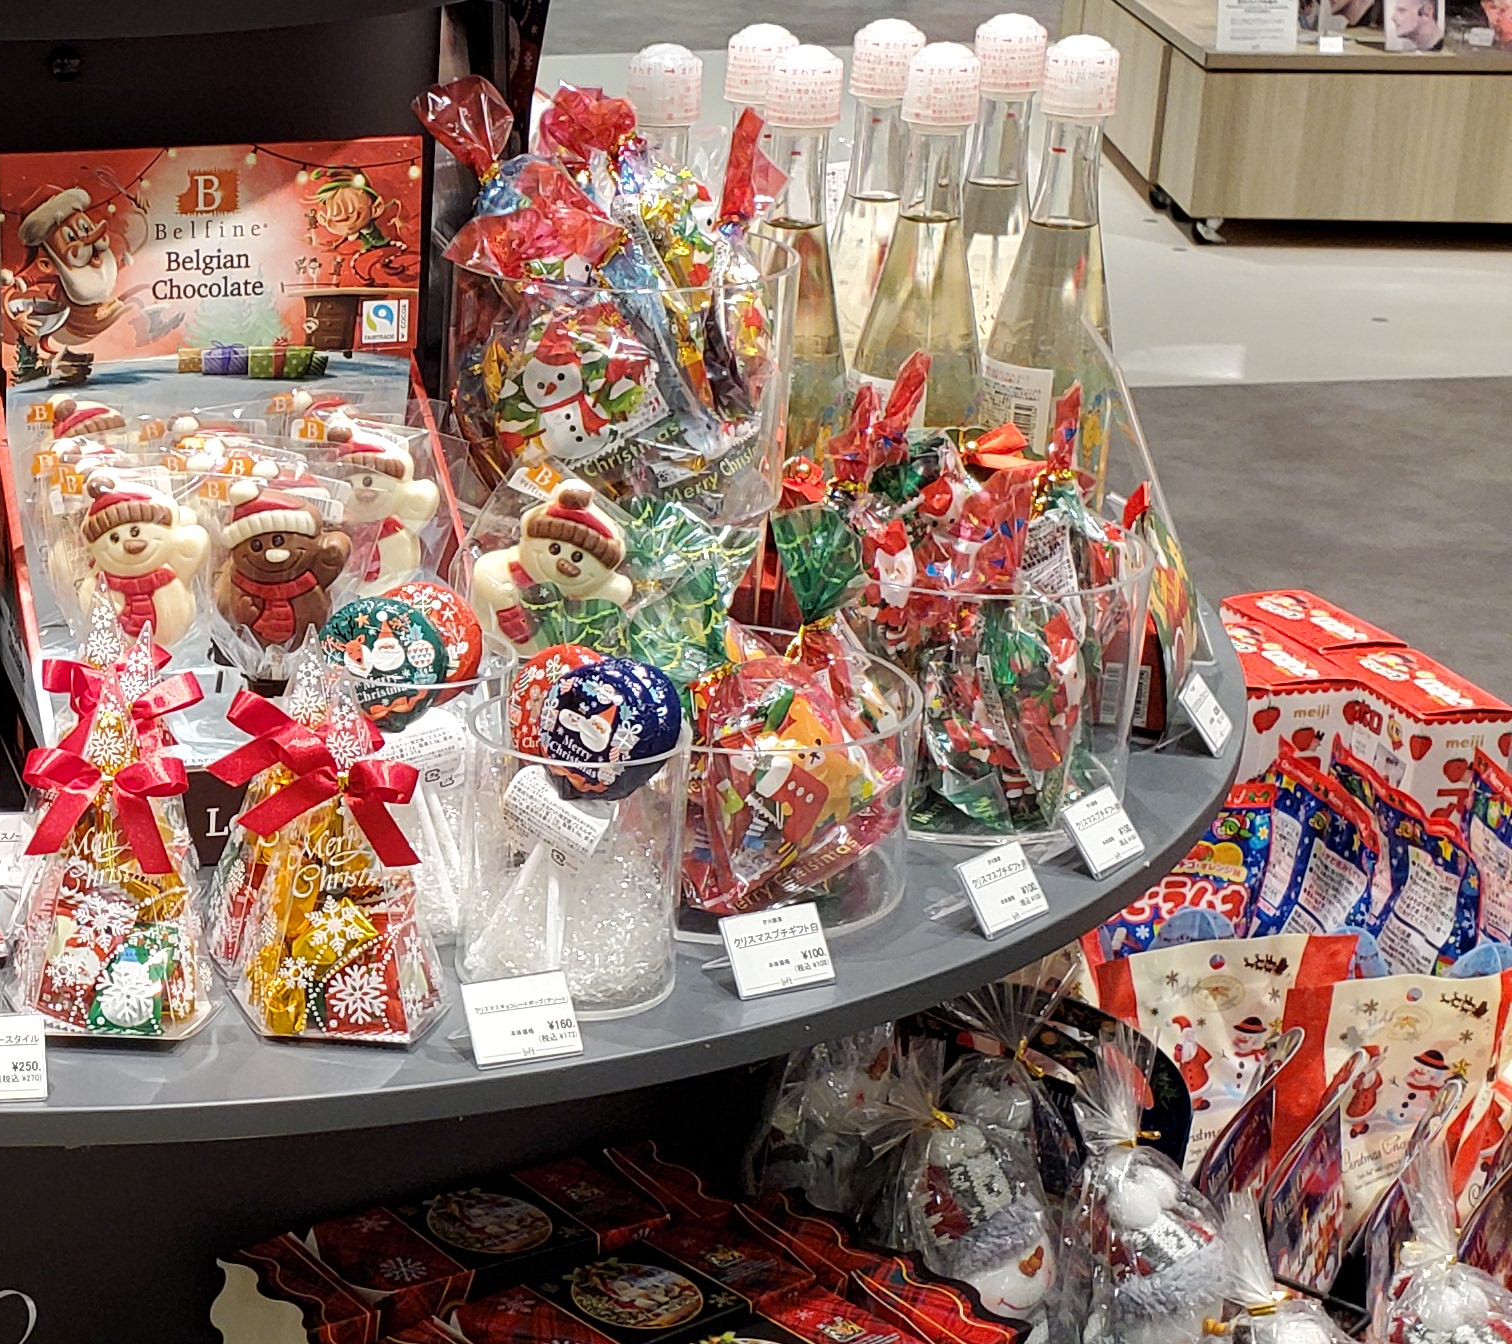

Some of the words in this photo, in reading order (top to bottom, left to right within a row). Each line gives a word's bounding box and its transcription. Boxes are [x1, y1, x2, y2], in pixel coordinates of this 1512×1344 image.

[194, 175, 222, 211] B
[155, 221, 262, 241] Belfine
[165, 249, 251, 275] Belgian
[151, 278, 264, 302] Chocolate
[1292, 703, 1332, 720] meiji
[1445, 735, 1486, 750] meiji
[733, 922, 819, 949] クリスマスプチギフト白
[800, 947, 828, 960] ¥100.
[546, 1018, 576, 1031] ¥160.
[11, 1060, 42, 1072] ¥250.
